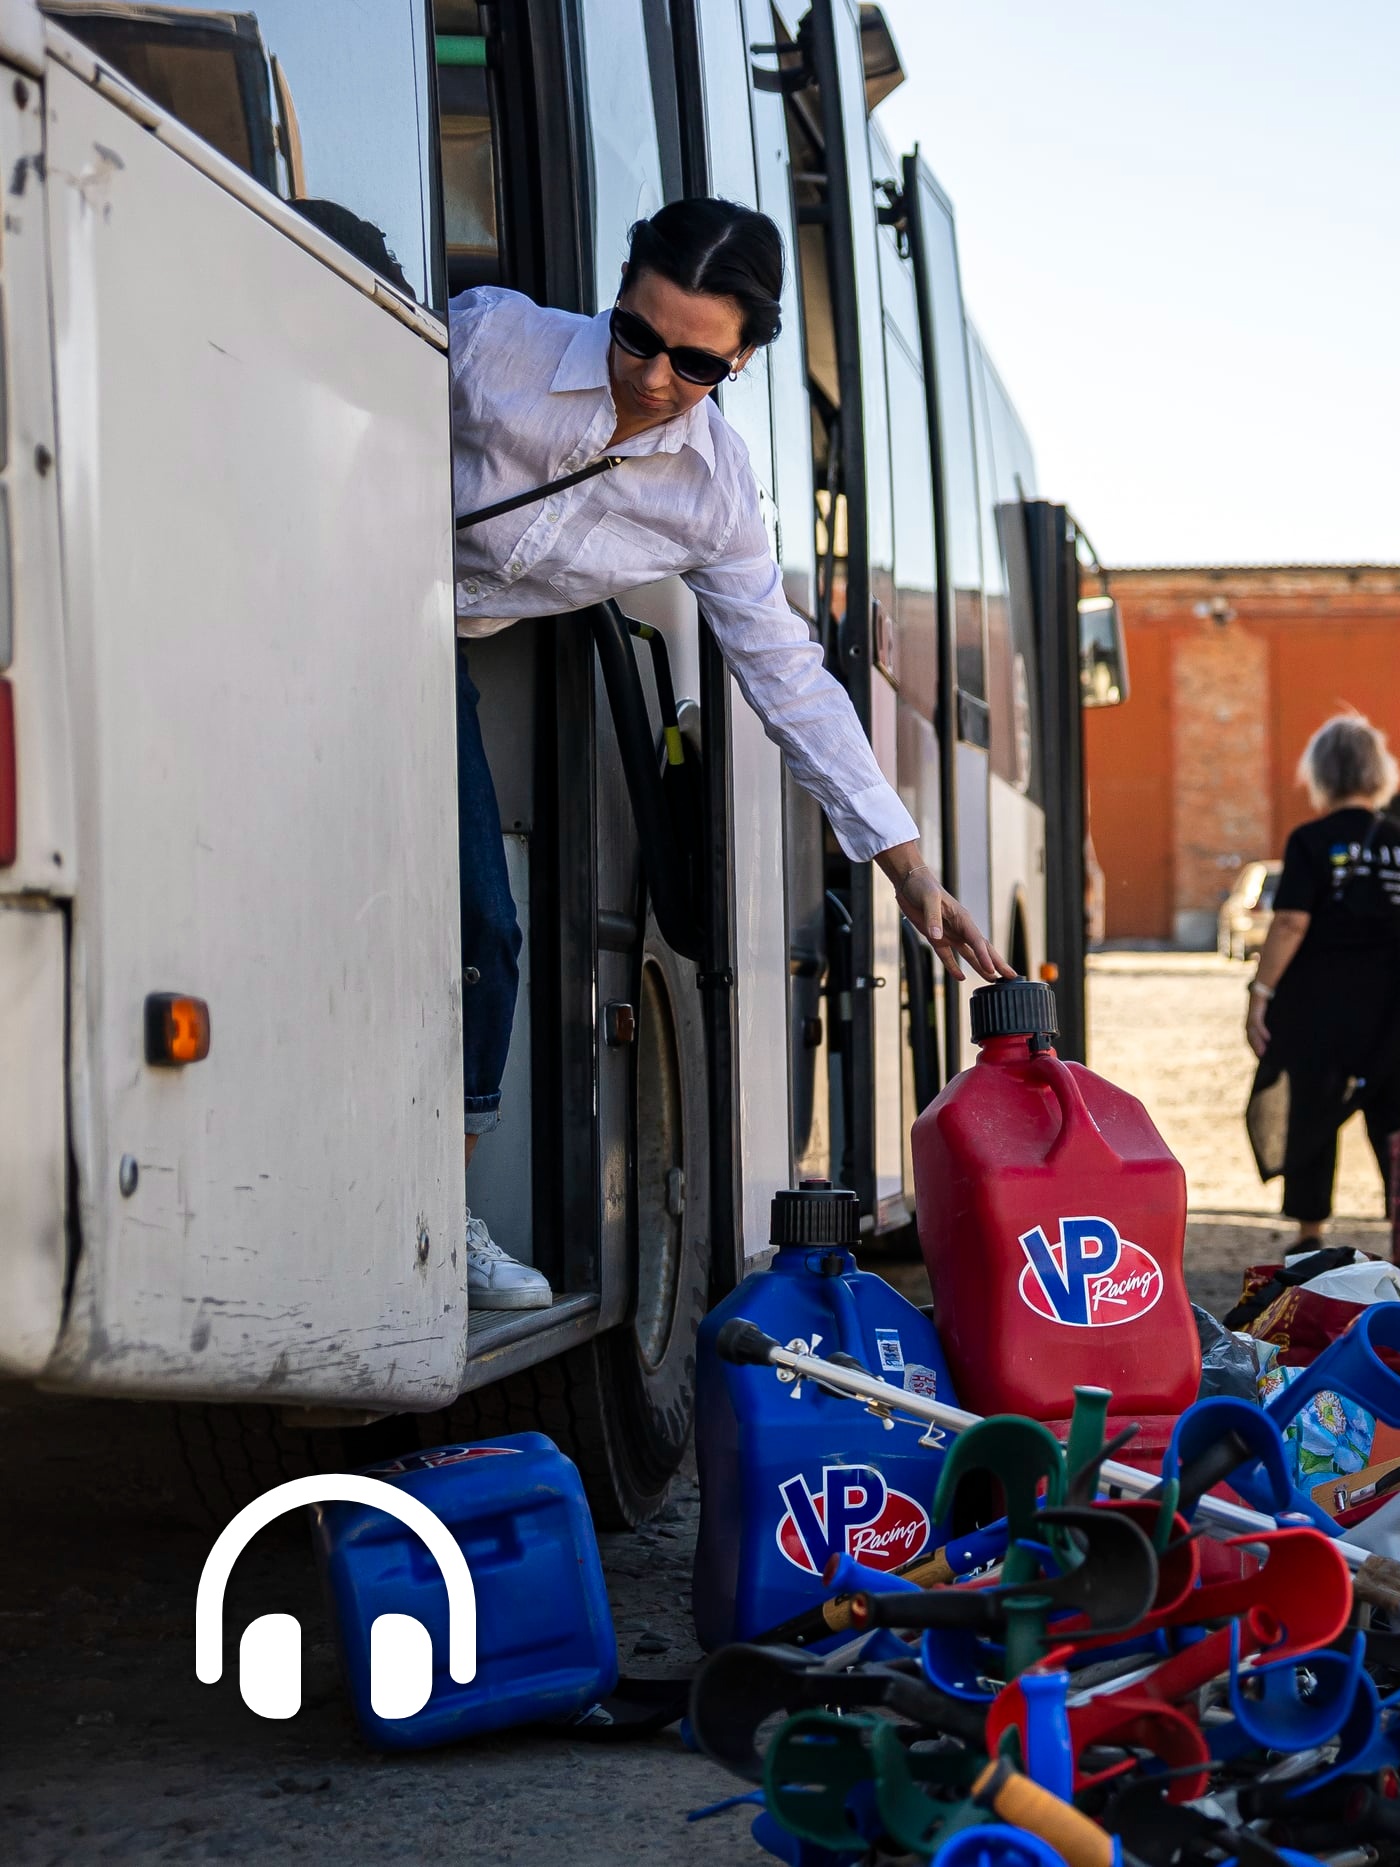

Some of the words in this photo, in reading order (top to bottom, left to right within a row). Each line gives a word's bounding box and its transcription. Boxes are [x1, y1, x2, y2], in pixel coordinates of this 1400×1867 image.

[1018, 1216, 1121, 1326] VP
[1092, 1270, 1159, 1311] Racing
[778, 1464, 888, 1576] VP
[853, 1520, 926, 1561] Racing
